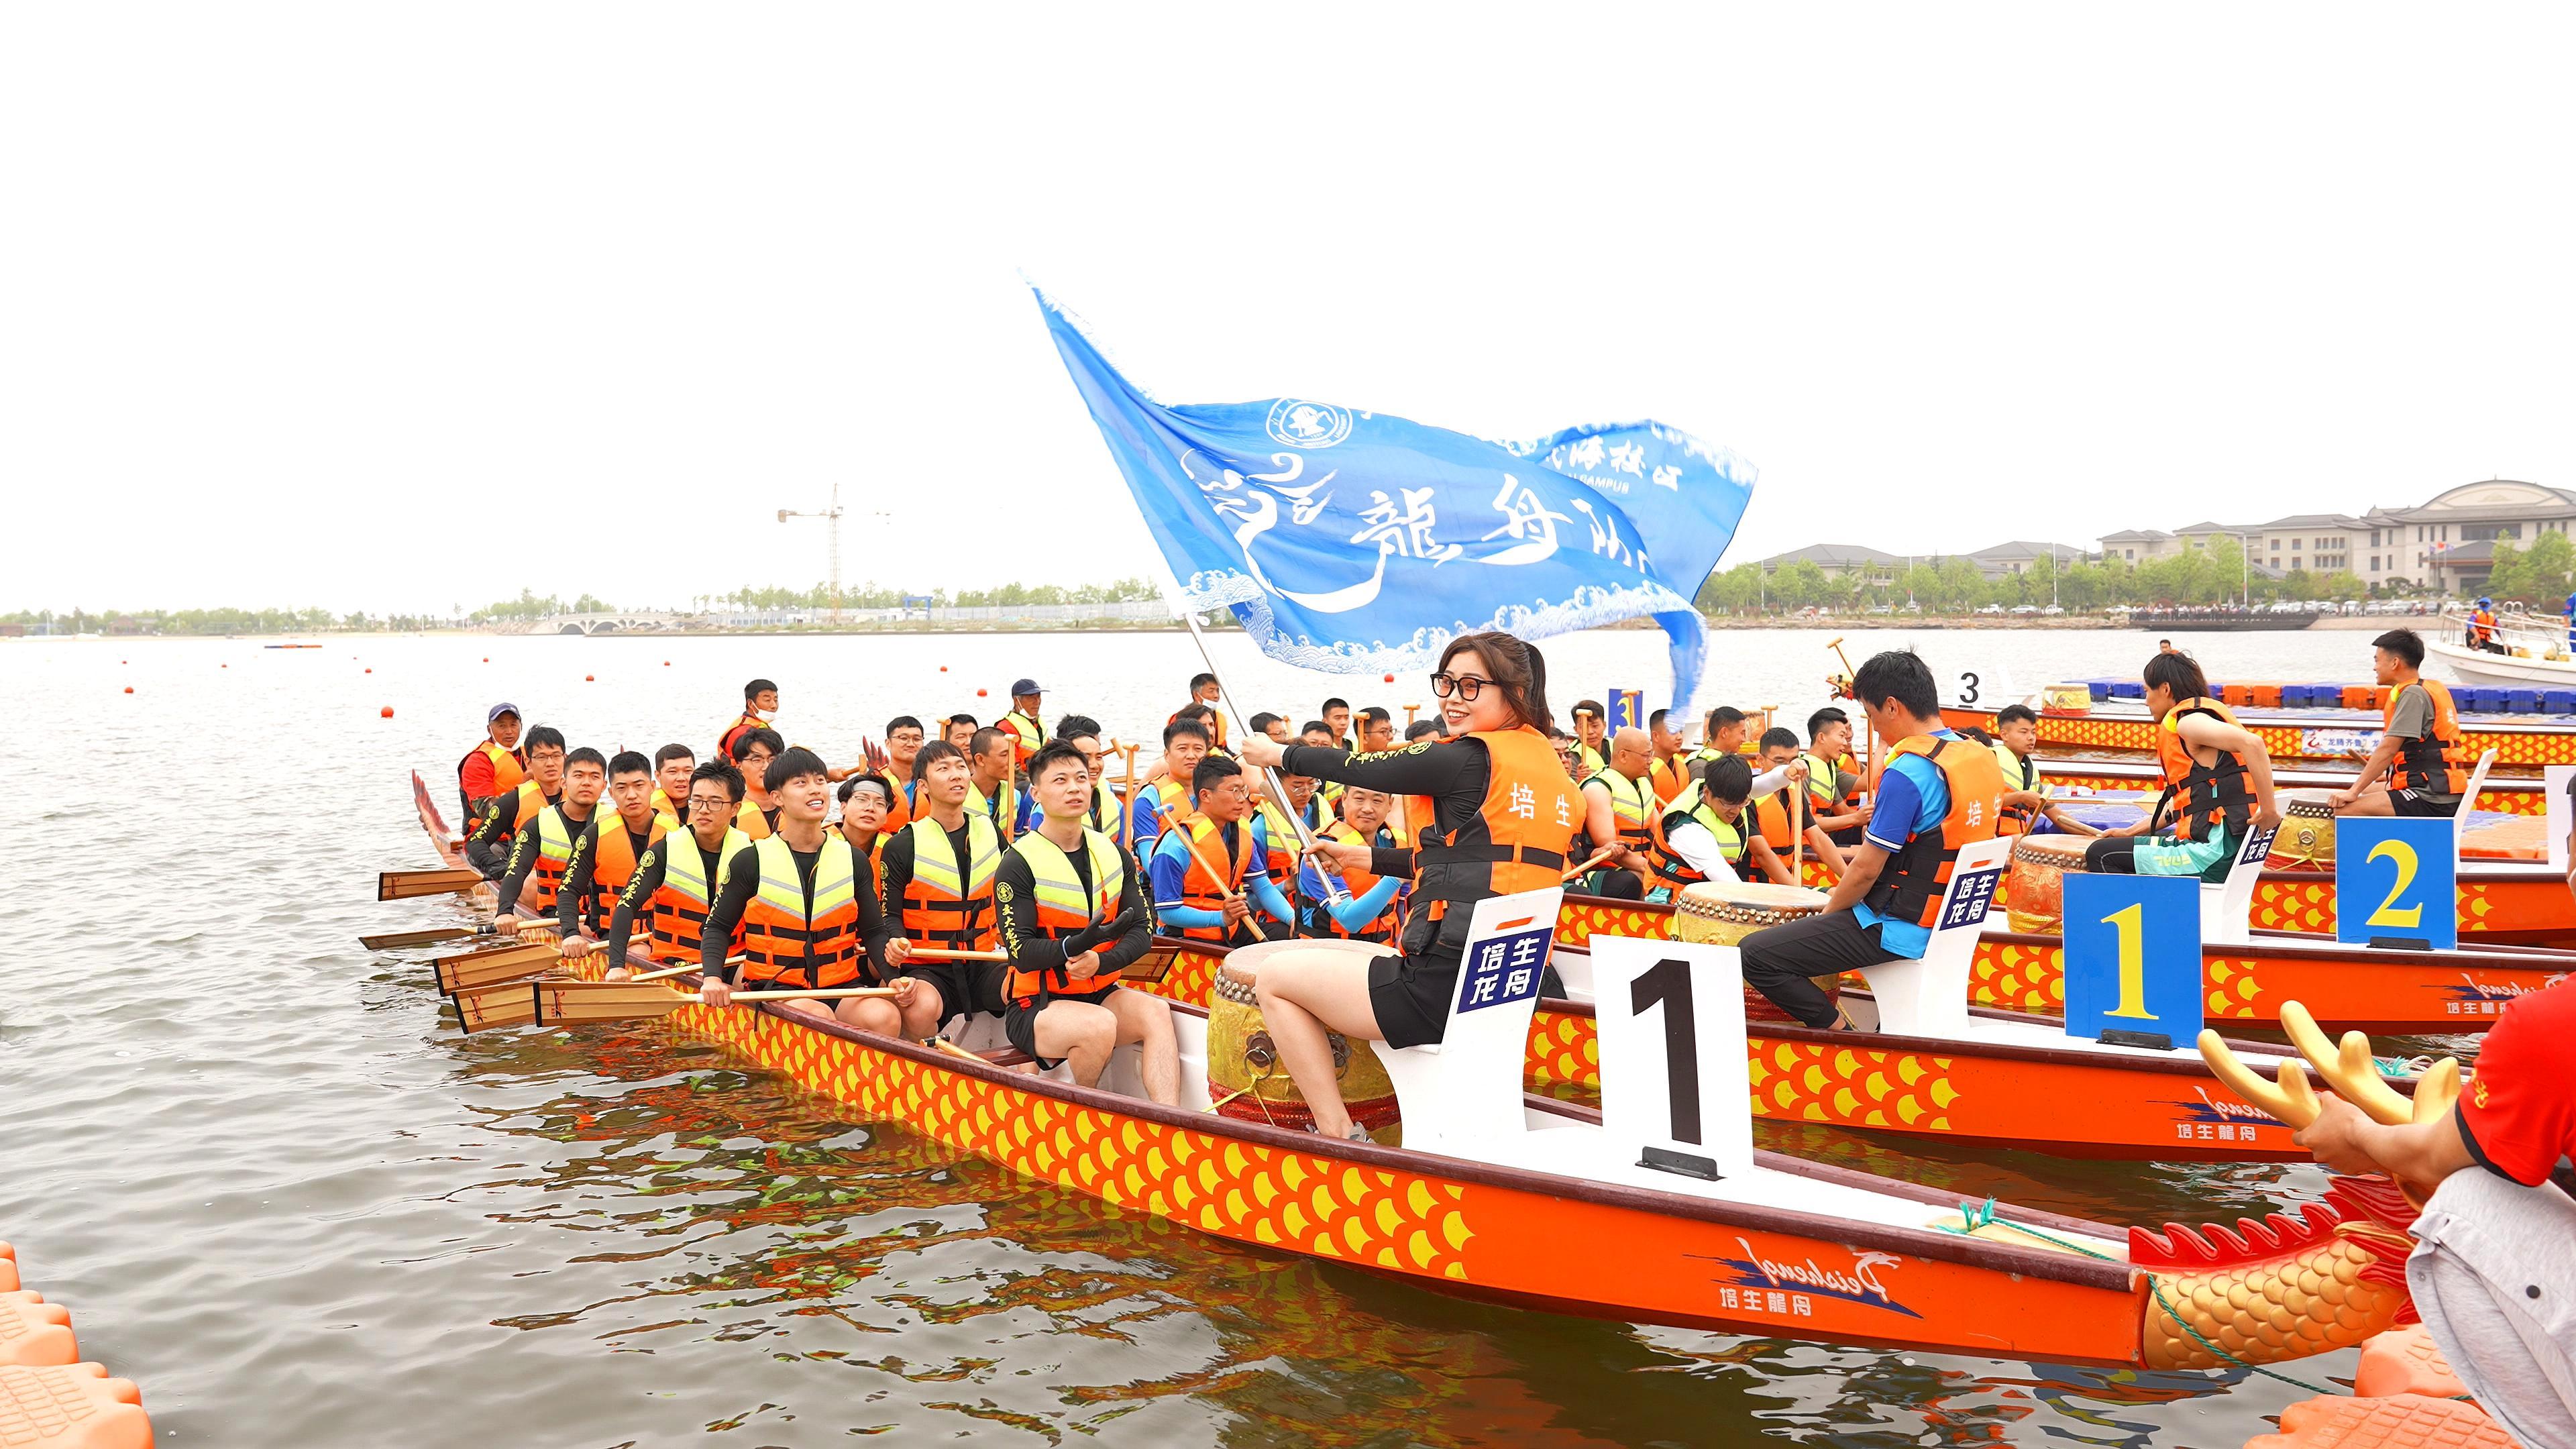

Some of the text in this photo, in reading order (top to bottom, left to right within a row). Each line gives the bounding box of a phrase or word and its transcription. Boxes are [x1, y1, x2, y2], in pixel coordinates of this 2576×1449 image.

[1956, 672, 1980, 704] 3
[1508, 782, 1571, 827] 培生
[2243, 842, 2270, 861] 龙舟
[1956, 874, 1995, 900] 培生
[2365, 839, 2423, 928] 2
[1947, 899, 1986, 924] 龙舟
[1477, 937, 1540, 973] 培生
[2100, 902, 2160, 1020] 1
[1469, 968, 1532, 1005] 龙舟
[1630, 959, 1703, 1146] 1
[2177, 1124, 2256, 1141] 培生龍舟
[1719, 1287, 1812, 1316] 培生龍舟
